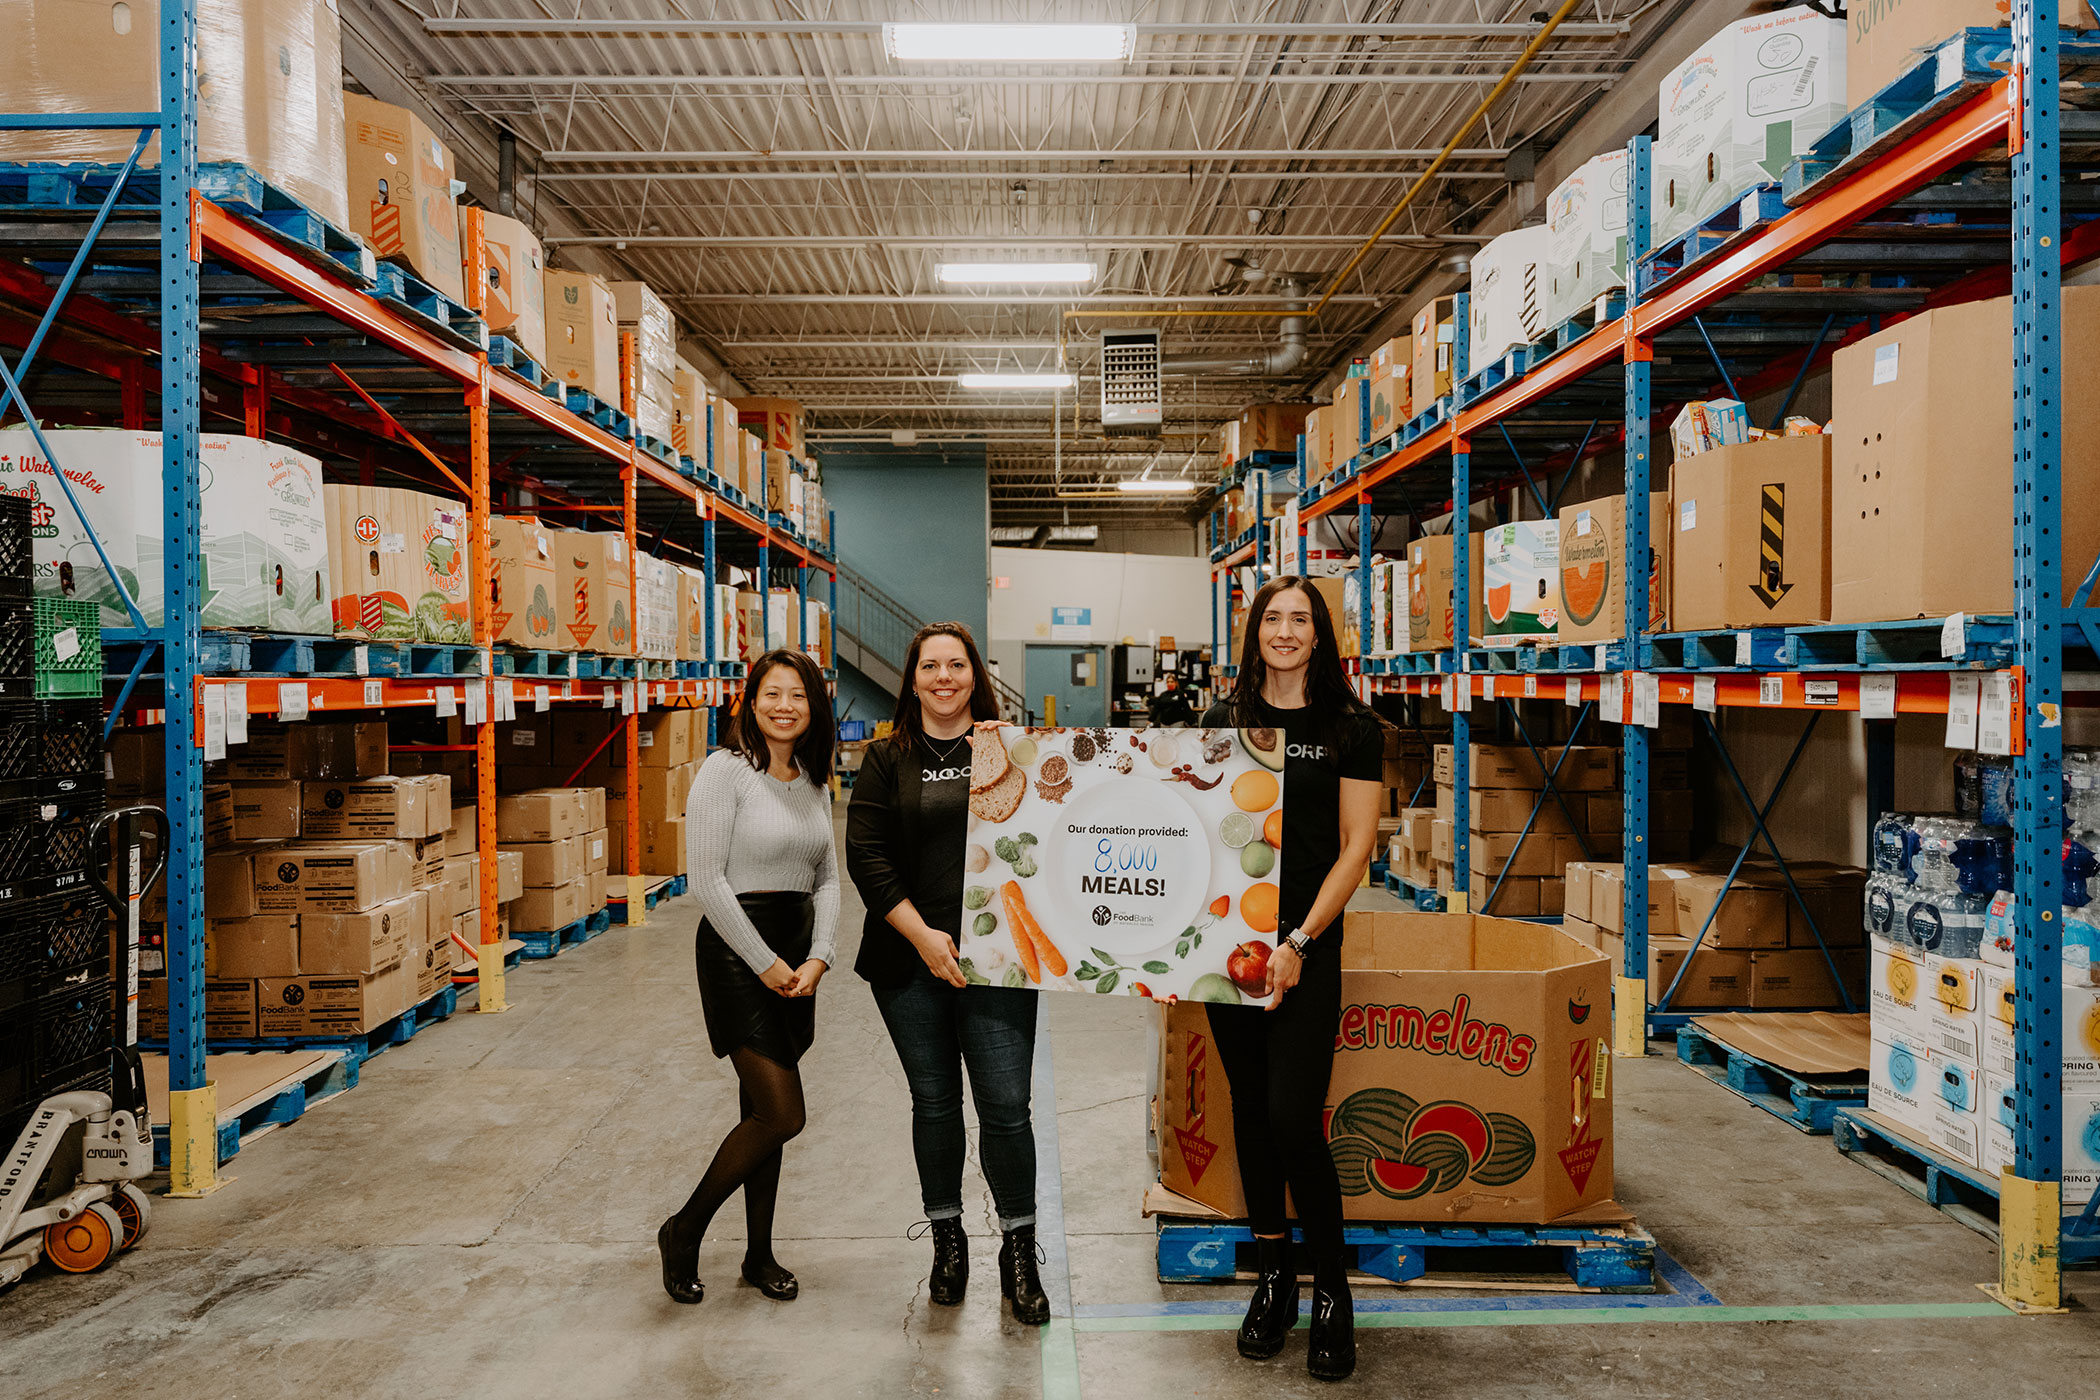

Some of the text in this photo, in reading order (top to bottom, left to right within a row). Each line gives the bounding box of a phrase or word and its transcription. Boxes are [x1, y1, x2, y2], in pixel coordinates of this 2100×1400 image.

[20, 456, 105, 494] Watemelon
[1068, 824, 1189, 838] Our donation provided:
[1095, 838, 1158, 874] 8,000
[256, 883, 300, 892] FoodBank
[1082, 876, 1166, 897] MEALS!
[1113, 913, 1155, 922] FoodBank
[261, 1005, 305, 1014] FoodBank
[1872, 989, 1918, 1013] EAU DE SOURCE
[1333, 995, 1536, 1077] ermelons
[2061, 1062, 2094, 1070] PRING
[1871, 1081, 1919, 1108] EAU DE SOURCE
[0, 1111, 54, 1196] BRANTFORD
[86, 1148, 128, 1159] CROWN
[1180, 1135, 1210, 1157] WATCH
[1185, 1151, 1206, 1167] STEP
[1565, 1146, 1596, 1164] WATCH
[1570, 1161, 1592, 1176] STEP
[2063, 1175, 2091, 1183] RING
